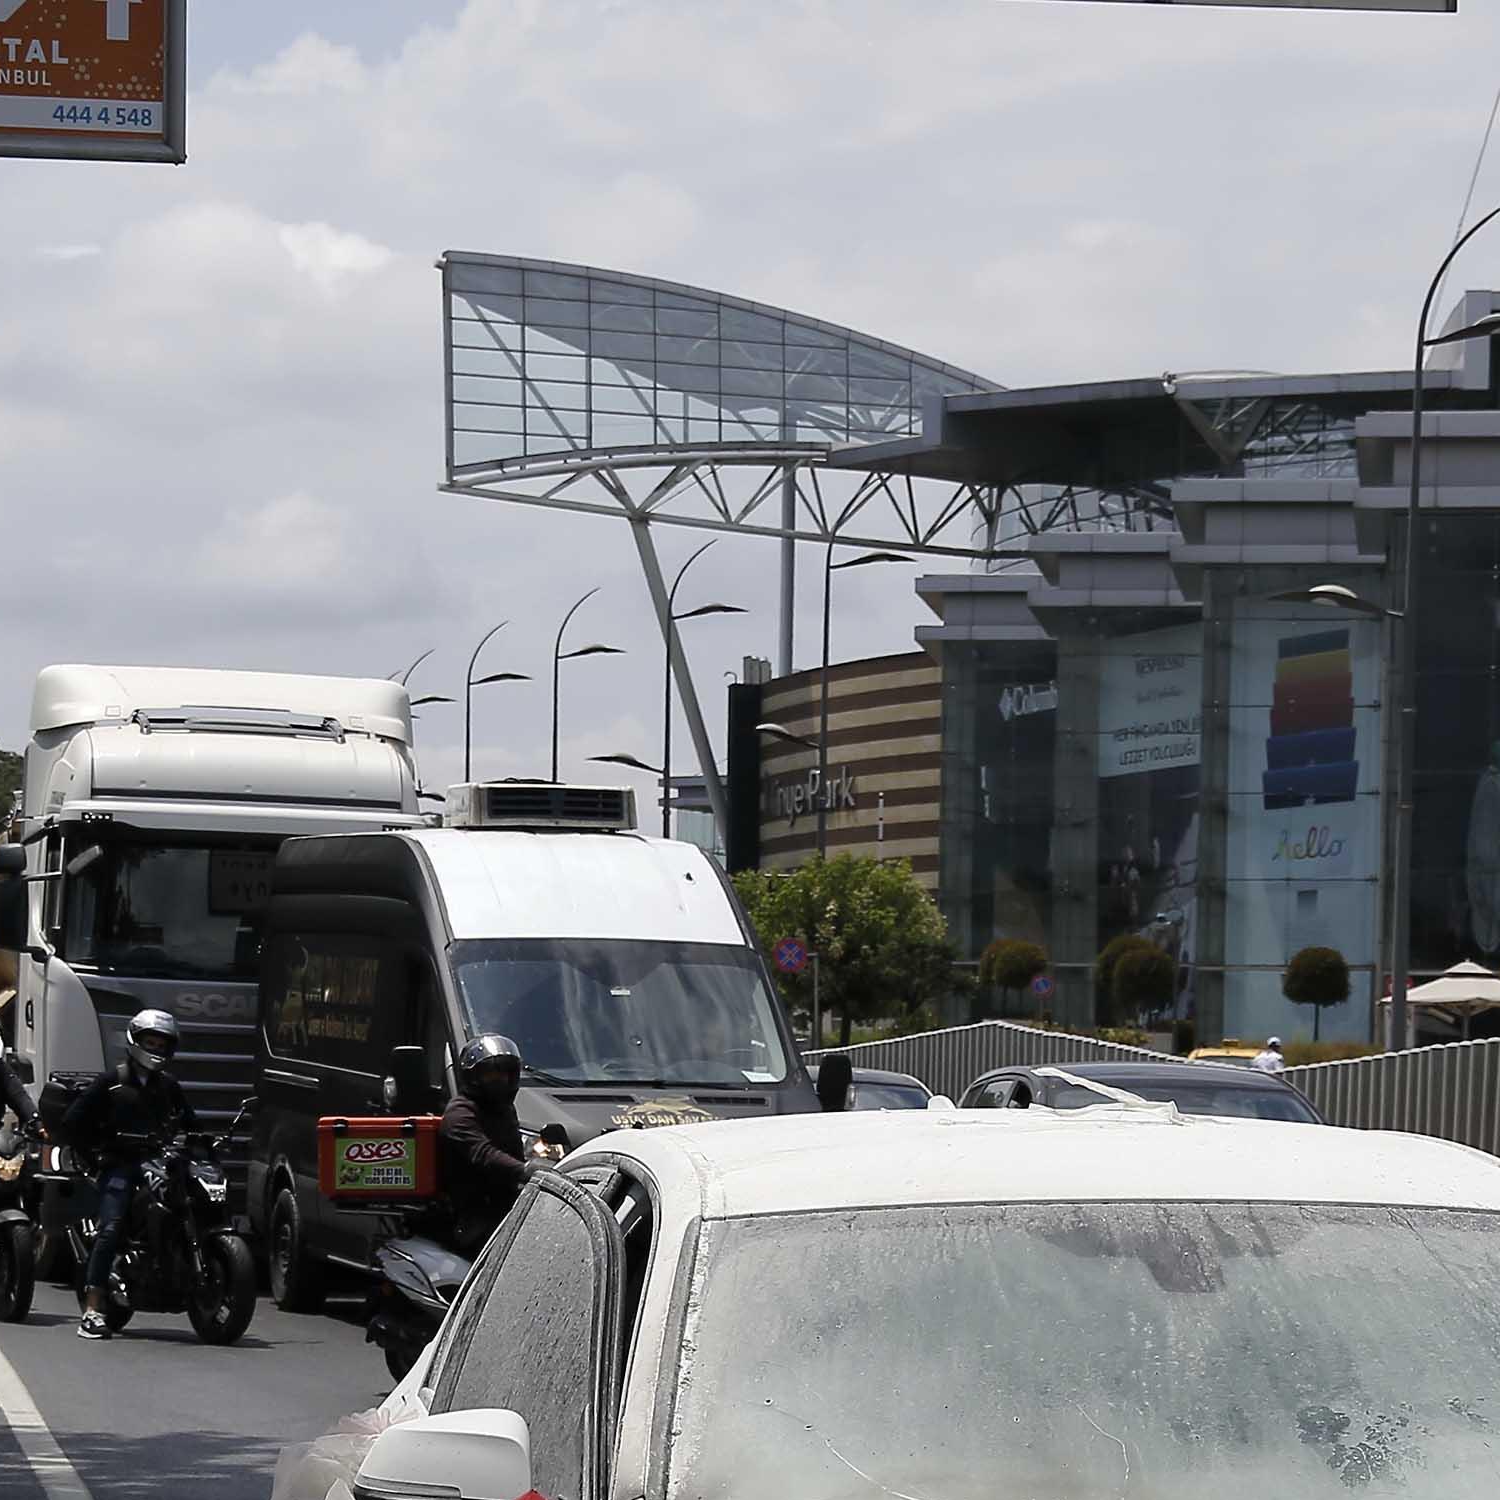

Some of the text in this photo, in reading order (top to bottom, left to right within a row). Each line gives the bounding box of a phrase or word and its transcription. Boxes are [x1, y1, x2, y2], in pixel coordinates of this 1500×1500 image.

[52, 104, 153, 127] 444 4 548
[1271, 826, 1344, 861] hello
[345, 1141, 406, 1160] oses
